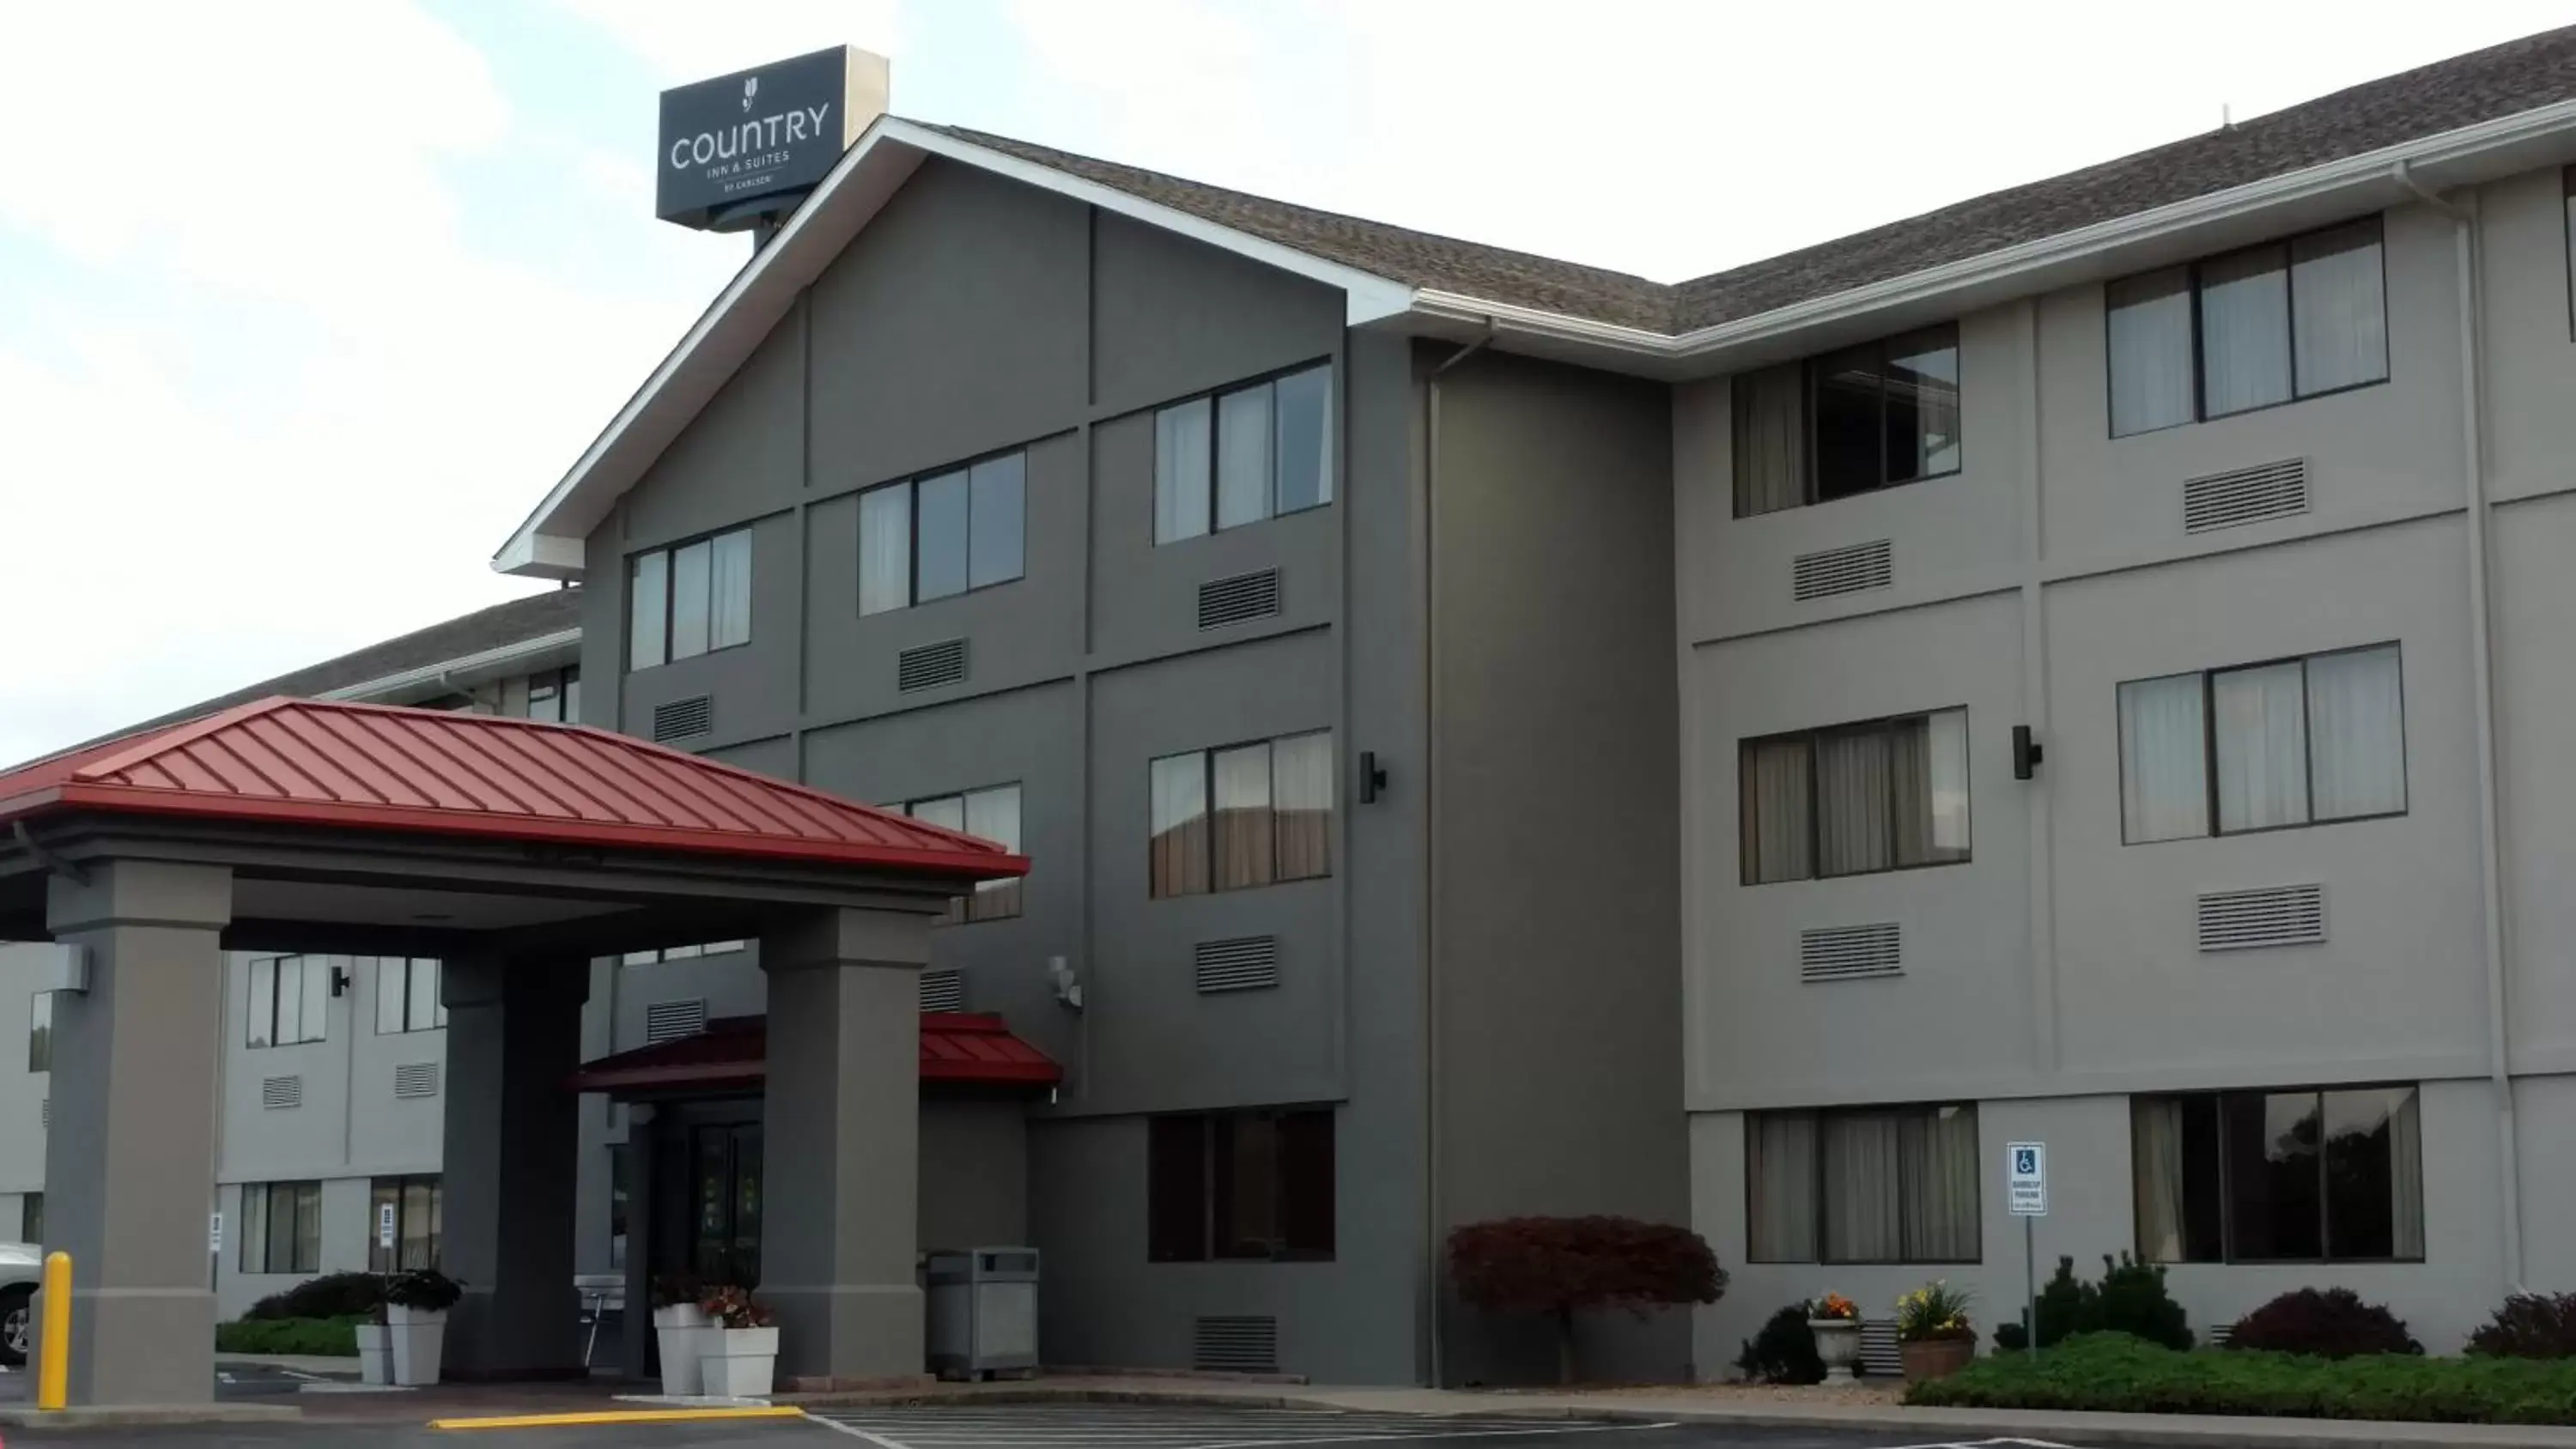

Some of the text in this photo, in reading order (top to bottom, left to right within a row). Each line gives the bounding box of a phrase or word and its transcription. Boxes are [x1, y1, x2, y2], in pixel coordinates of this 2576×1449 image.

[671, 102, 829, 169] COUNTRY
[706, 150, 790, 179] INN & SUITES
